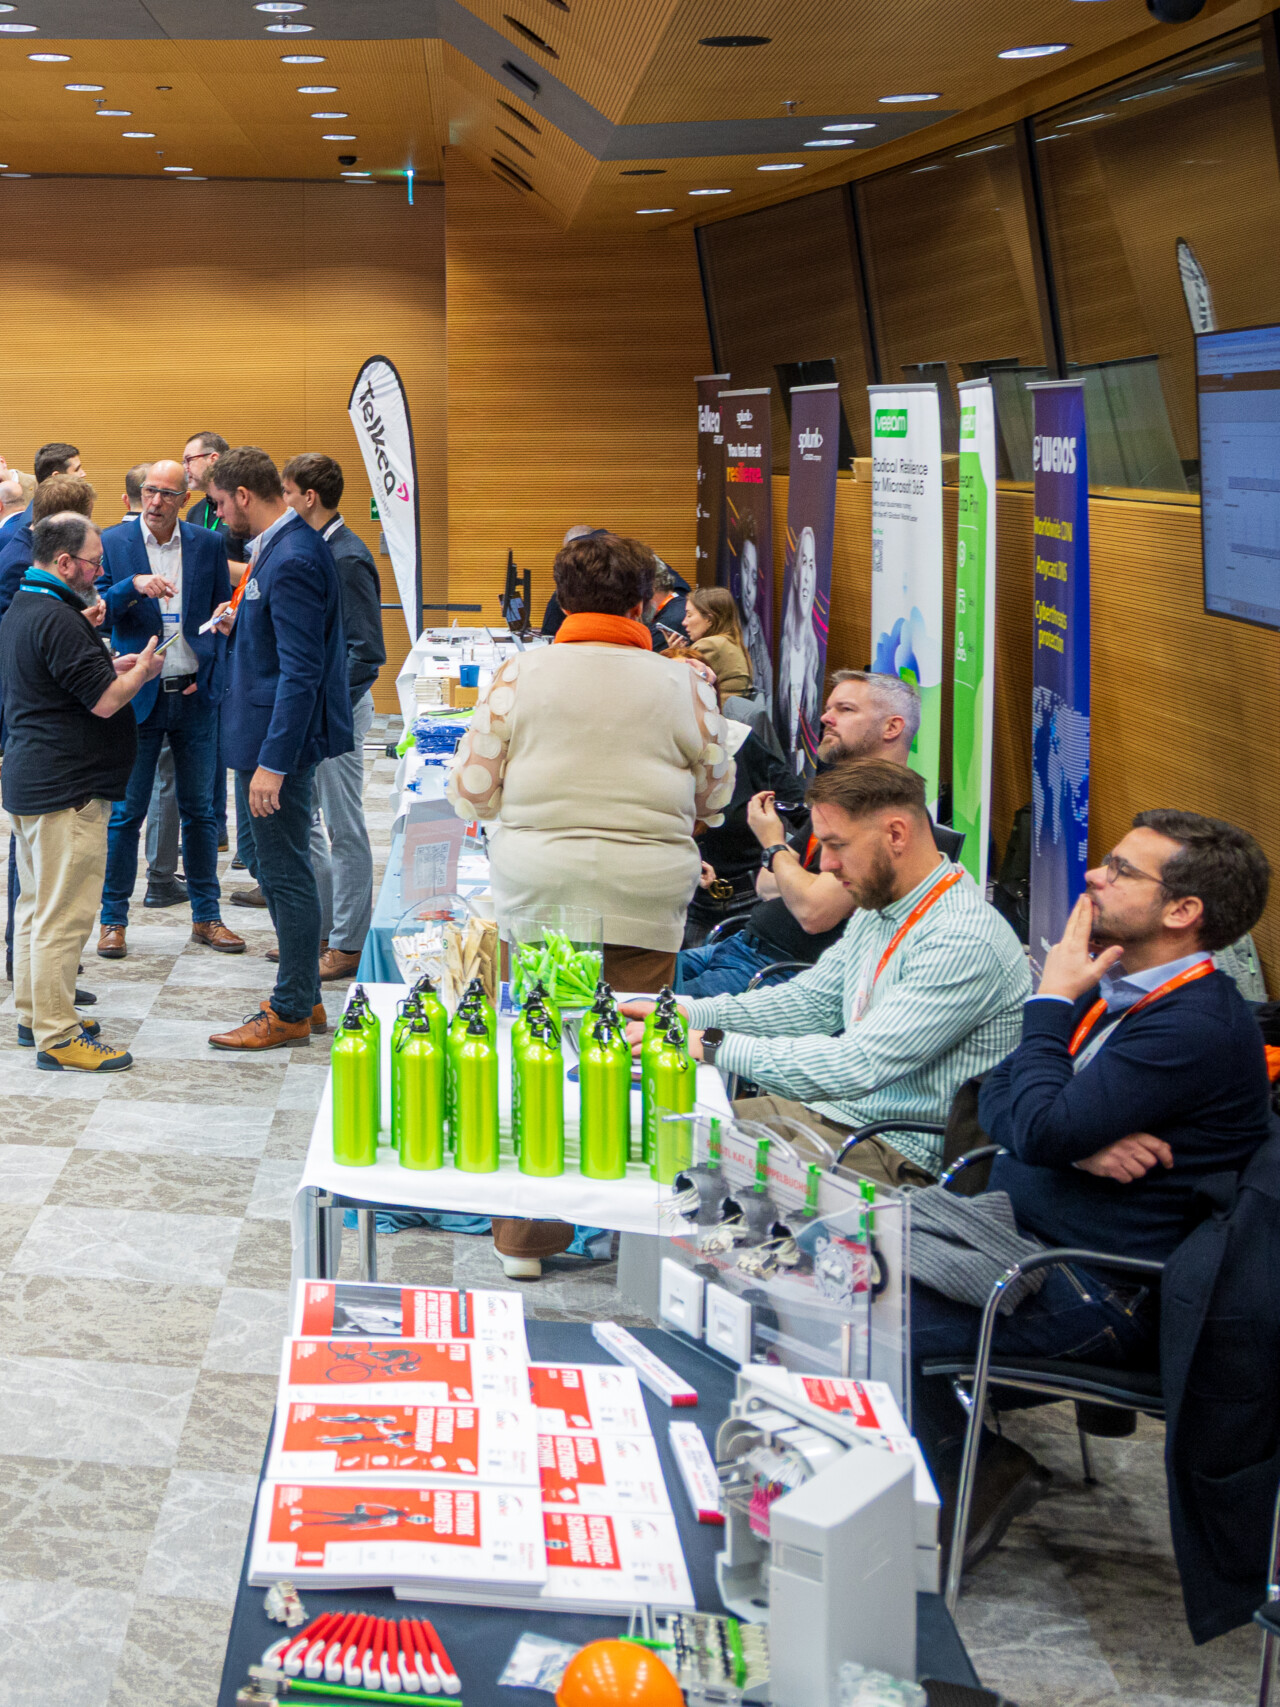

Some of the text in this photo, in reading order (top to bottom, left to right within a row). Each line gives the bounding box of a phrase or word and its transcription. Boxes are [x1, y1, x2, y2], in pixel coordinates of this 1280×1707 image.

[876, 416, 906, 431] veeam
[435, 1408, 454, 1443] NETWORK
[433, 1491, 453, 1535] CABINETS
[455, 1492, 475, 1536] NETWORK
[565, 1514, 593, 1564] SCHRÄNKE
[587, 1516, 615, 1567] NETZWERK-
